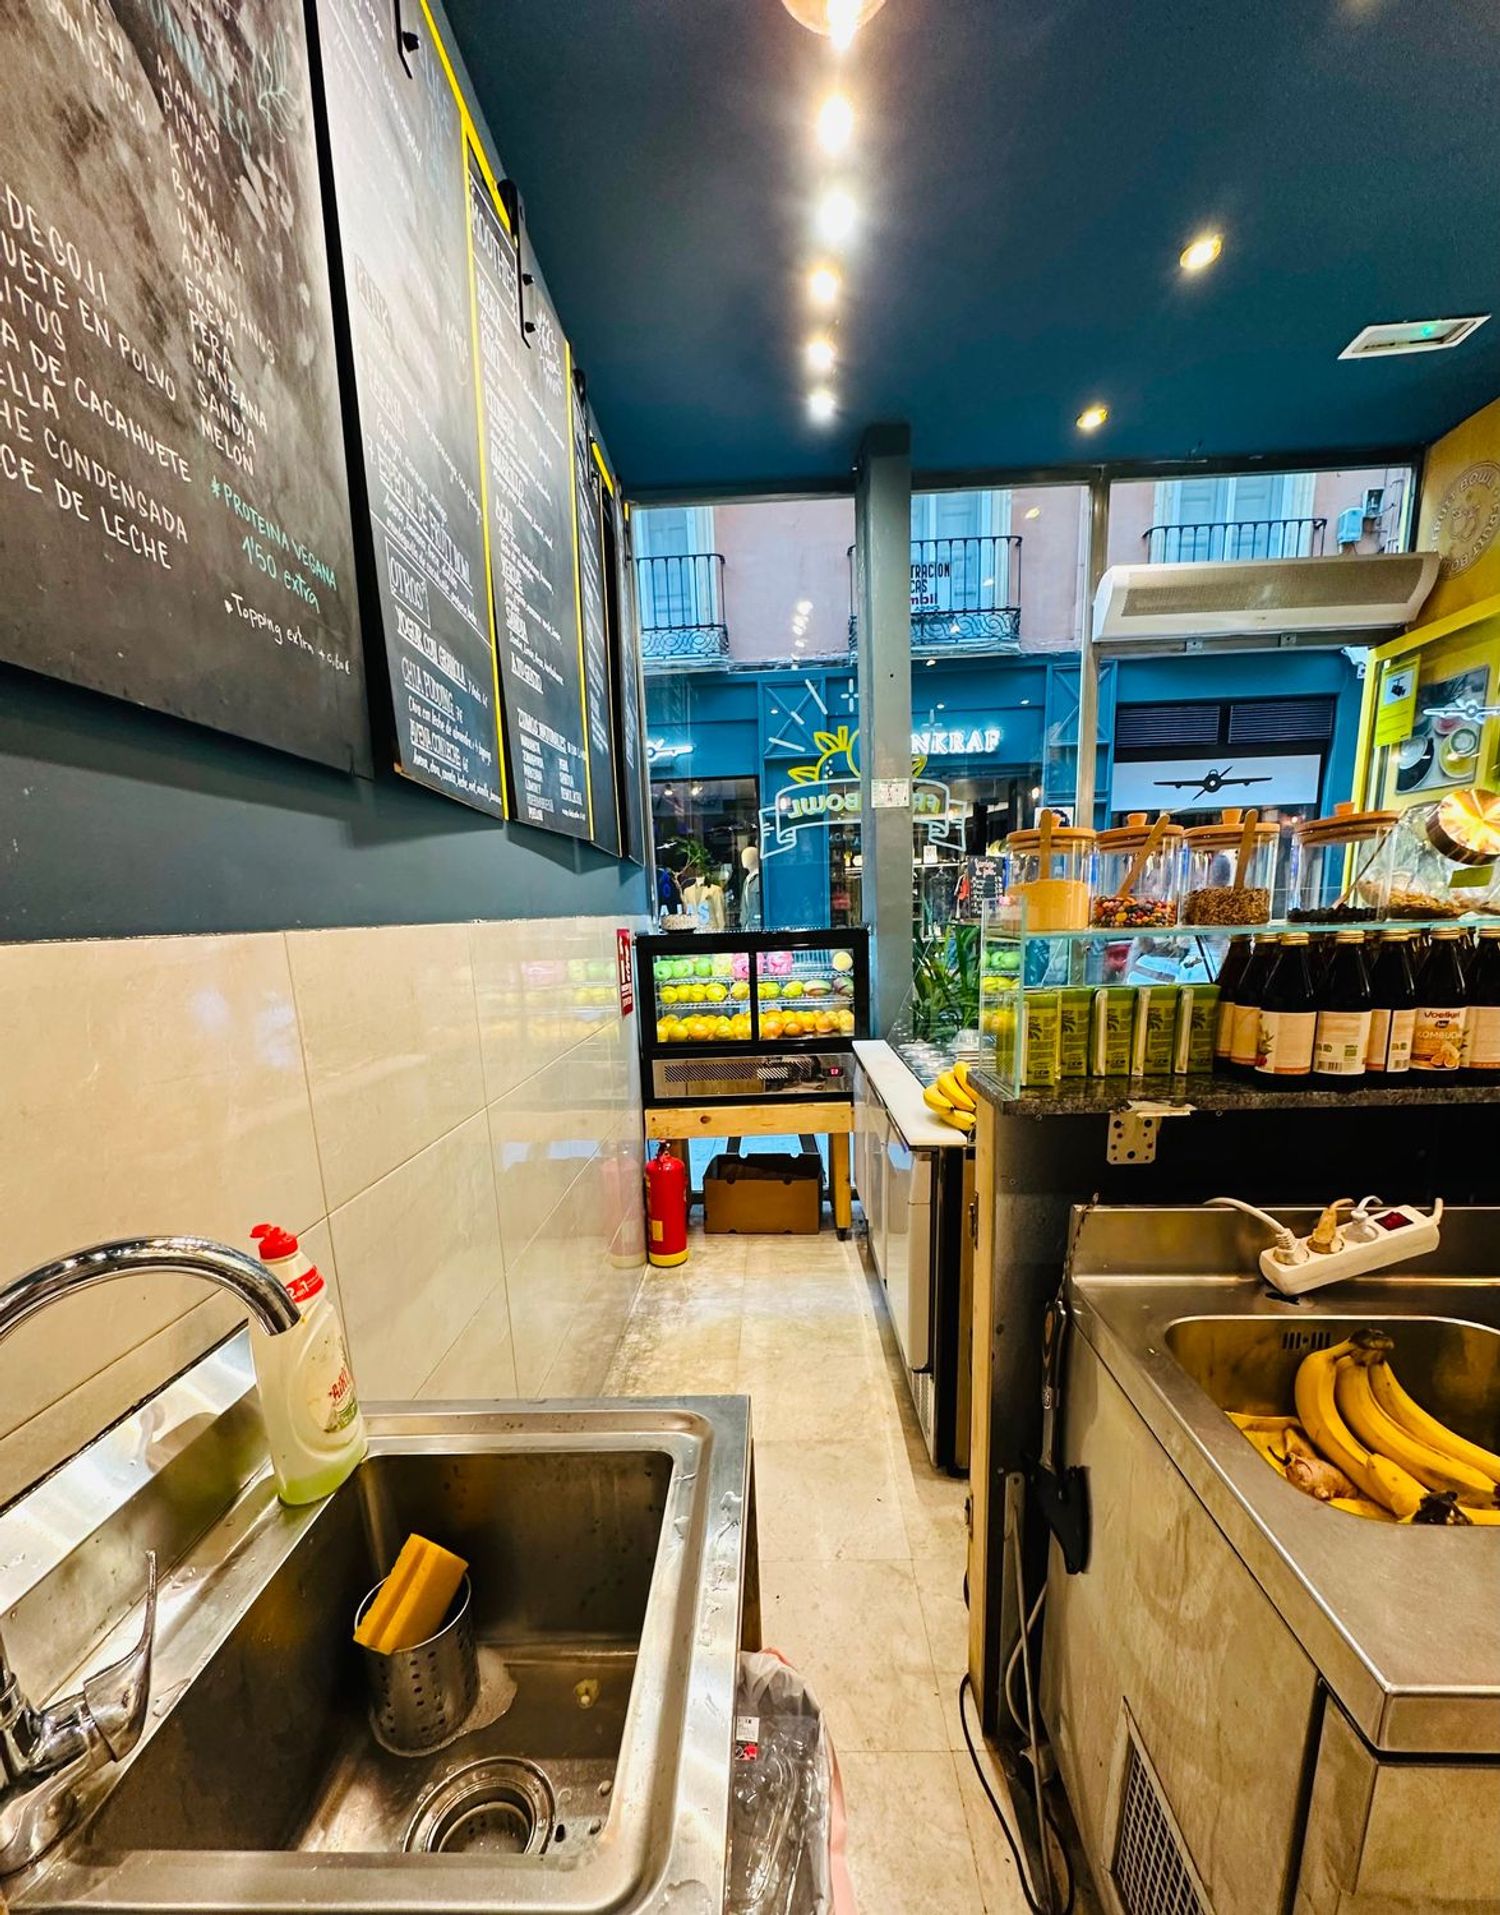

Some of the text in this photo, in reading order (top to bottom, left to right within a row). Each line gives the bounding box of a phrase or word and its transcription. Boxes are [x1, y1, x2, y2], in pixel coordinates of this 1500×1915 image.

[156, 54, 220, 154] MANGO
[167, 127, 214, 207] KIWI
[6, 183, 108, 306] DE GOJI
[171, 167, 244, 274] BANANA
[1, 230, 176, 401] UETE EN POLVO
[189, 308, 234, 371] PERA
[29, 339, 66, 387] DE
[75, 377, 192, 482] CACAHUETE
[192, 342, 267, 434] MANZANA
[44, 427, 189, 545] CONDENSADA
[55, 478, 90, 521] DE
[100, 506, 172, 570] LECHE
[283, 570, 321, 614] extra
[291, 538, 338, 591] VEGANA
[389, 555, 426, 612] OTROS
[231, 592, 283, 645] Topping
